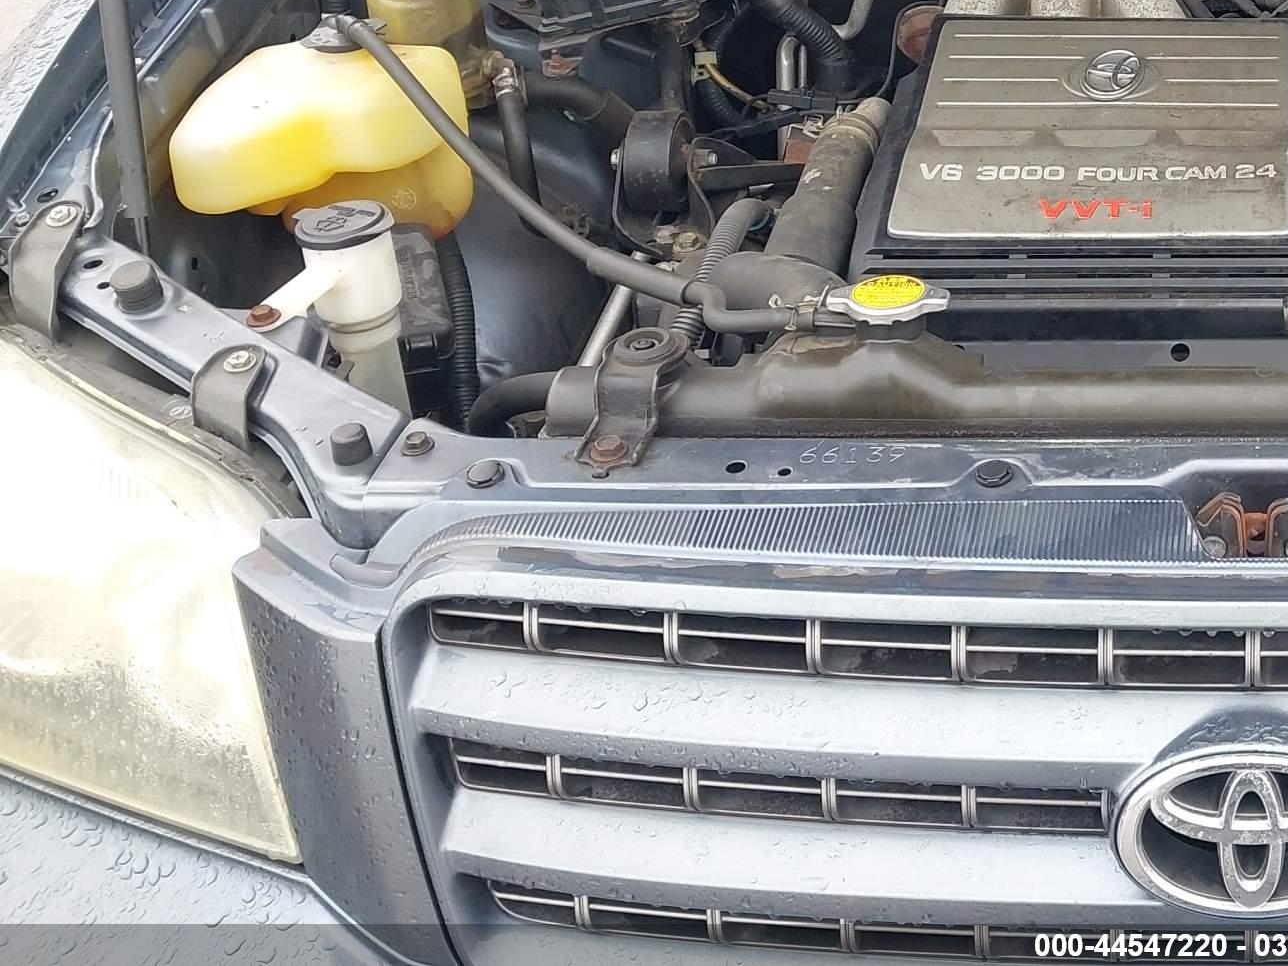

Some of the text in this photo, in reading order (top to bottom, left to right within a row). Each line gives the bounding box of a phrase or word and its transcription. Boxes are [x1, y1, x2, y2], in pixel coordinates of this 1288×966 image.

[919, 162, 1277, 182] V6 3000 FOUR CAM 24
[1038, 198, 1152, 220] VVT-i
[799, 446, 907, 464] 66139
